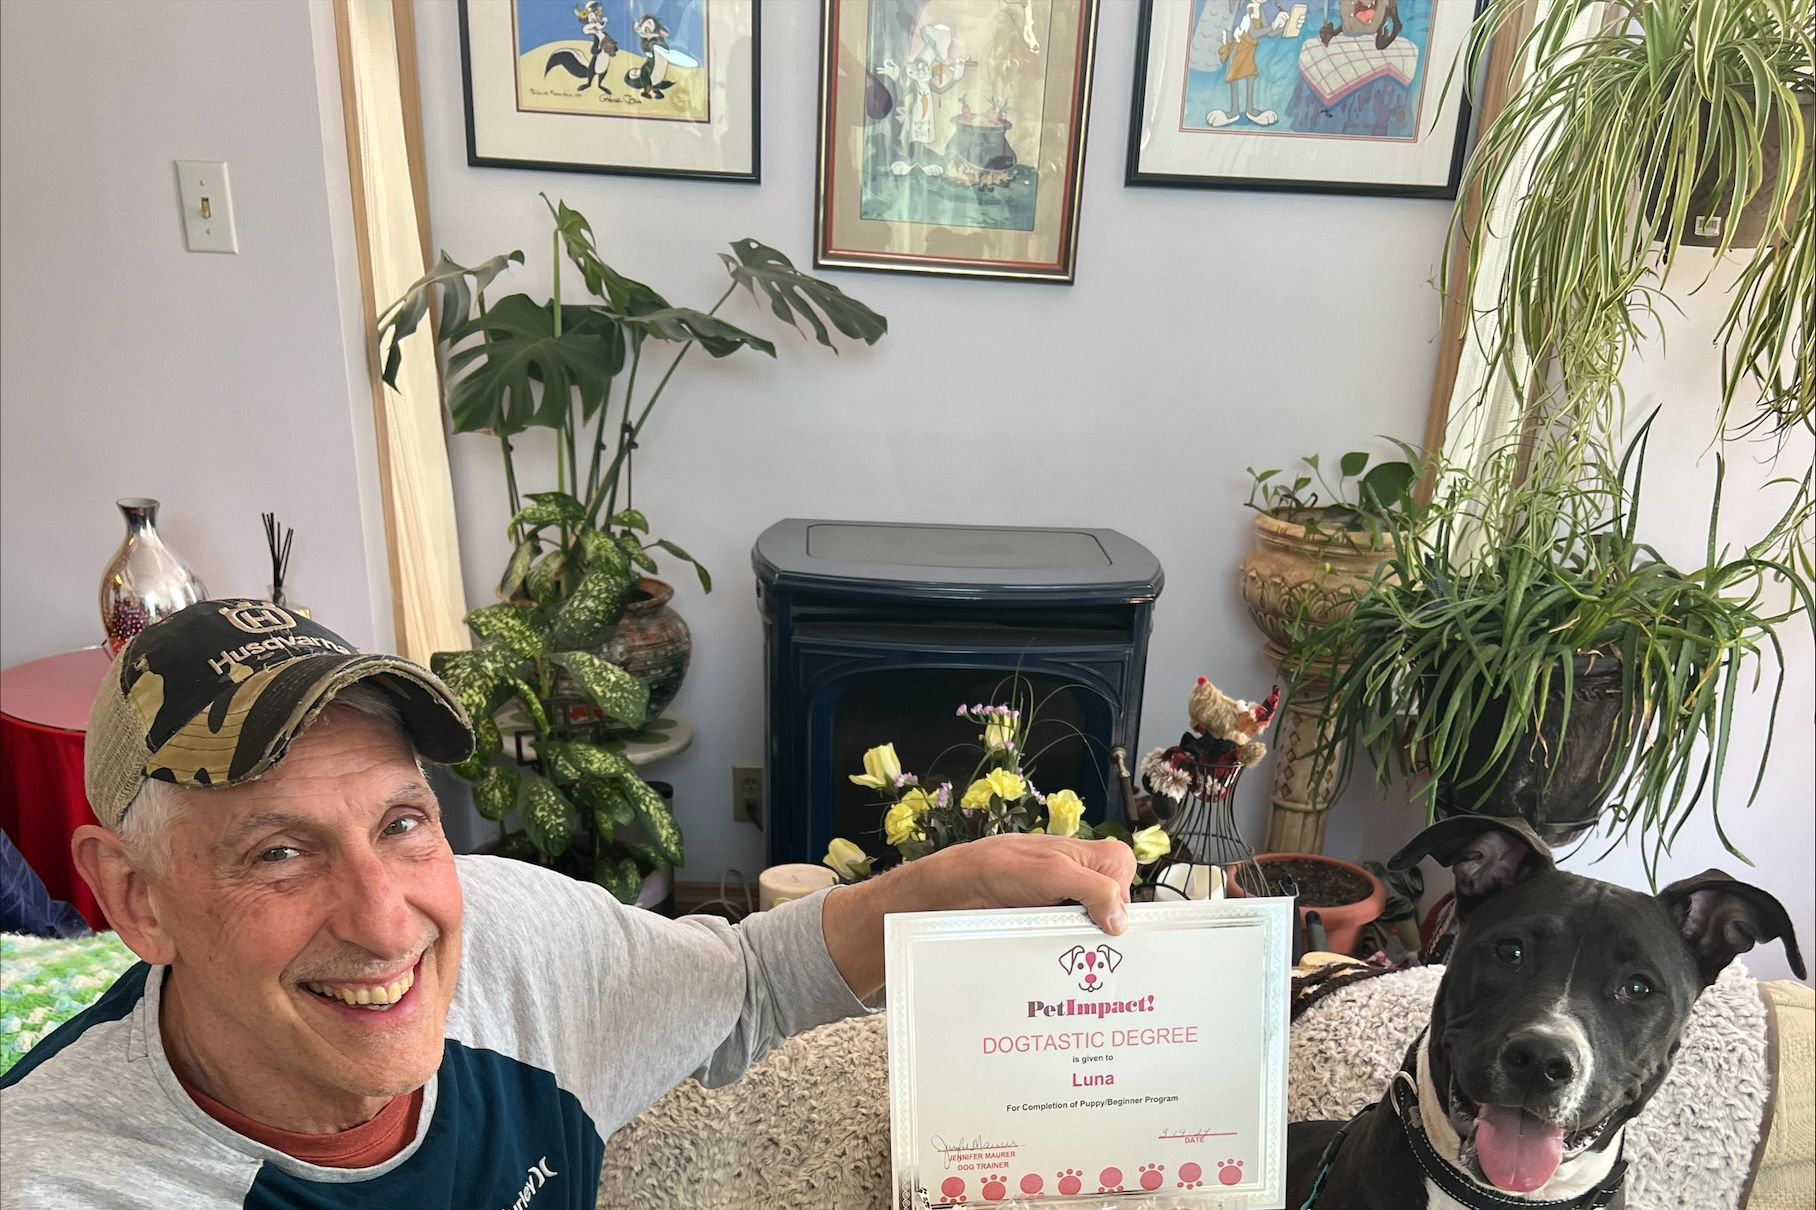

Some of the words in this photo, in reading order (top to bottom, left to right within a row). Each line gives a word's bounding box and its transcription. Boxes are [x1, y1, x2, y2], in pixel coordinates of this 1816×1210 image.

[1027, 995, 1155, 1019] PetImpact!
[983, 1031, 1105, 1054] DOGTASTIC
[1111, 1026, 1199, 1047] DEGREE
[1072, 1055, 1080, 1063] is
[1081, 1055, 1104, 1064] given
[1105, 1054, 1114, 1062] to
[1072, 1072, 1115, 1088] Luna
[1006, 1104, 1021, 1112] For
[1022, 1101, 1068, 1112] Completion
[1070, 1100, 1078, 1109] of
[1080, 1096, 1143, 1109] Puppy/Beginner
[1144, 1095, 1179, 1105] Program
[1184, 1136, 1205, 1144] DATE
[949, 1152, 983, 1161] JENNIFER
[984, 1150, 1016, 1159] MAURER
[957, 1163, 975, 1171] DOG
[977, 1161, 1010, 1170] TRAINER
